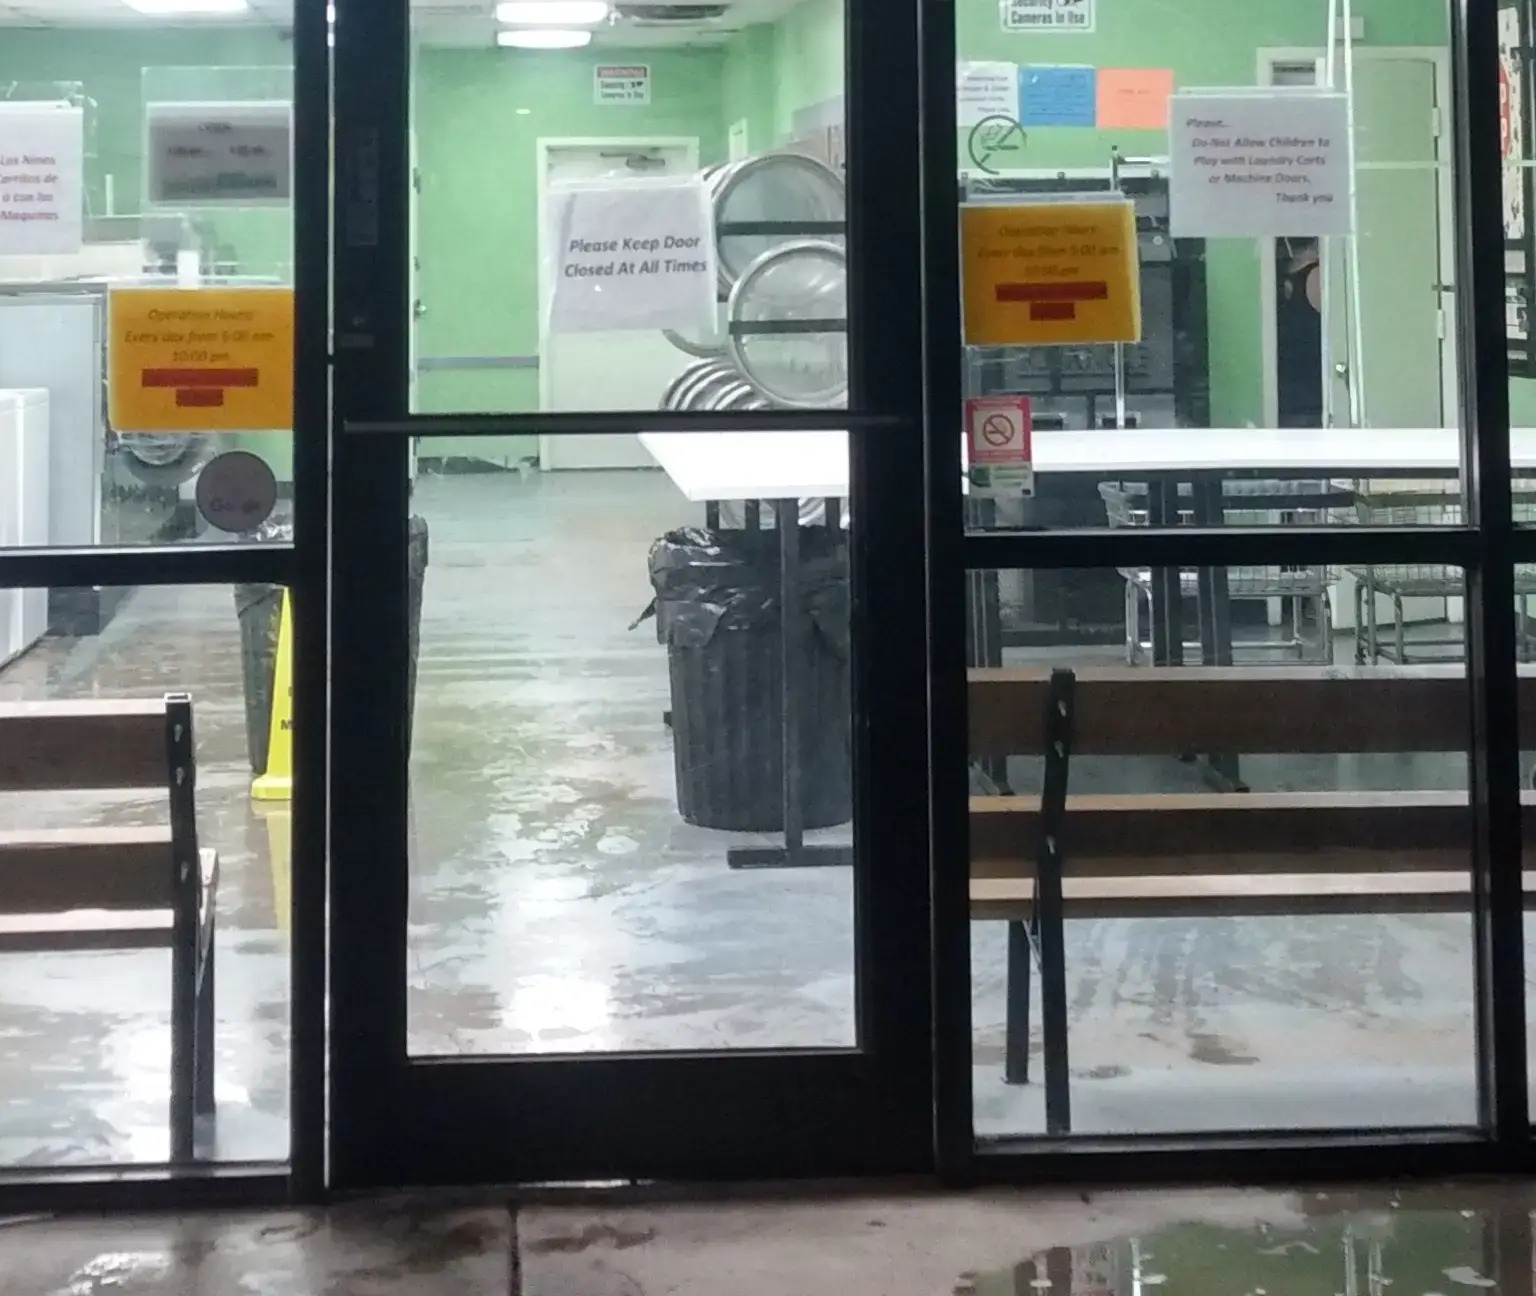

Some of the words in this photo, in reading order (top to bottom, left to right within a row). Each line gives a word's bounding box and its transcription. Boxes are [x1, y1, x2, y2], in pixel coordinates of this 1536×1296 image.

[1011, 10, 1052, 24] Cameras
[1235, 138, 1264, 147] Allow
[1269, 137, 1315, 147] Children
[1318, 137, 1330, 147] to
[1194, 156, 1217, 167] Play
[1221, 156, 1246, 165] with
[1249, 156, 1293, 166] Laundry
[1296, 155, 1325, 165] Carts
[44, 173, 58, 184] de
[1209, 175, 1221, 183] or
[1223, 173, 1271, 183] Machine
[1276, 193, 1309, 203] Thank
[1313, 194, 1333, 204] you
[569, 239, 618, 253] Please
[622, 238, 659, 252] Keep
[664, 235, 700, 249] Door
[565, 262, 614, 277] Closed
[618, 262, 636, 276] At
[639, 260, 659, 274] All
[664, 259, 707, 273] Times
